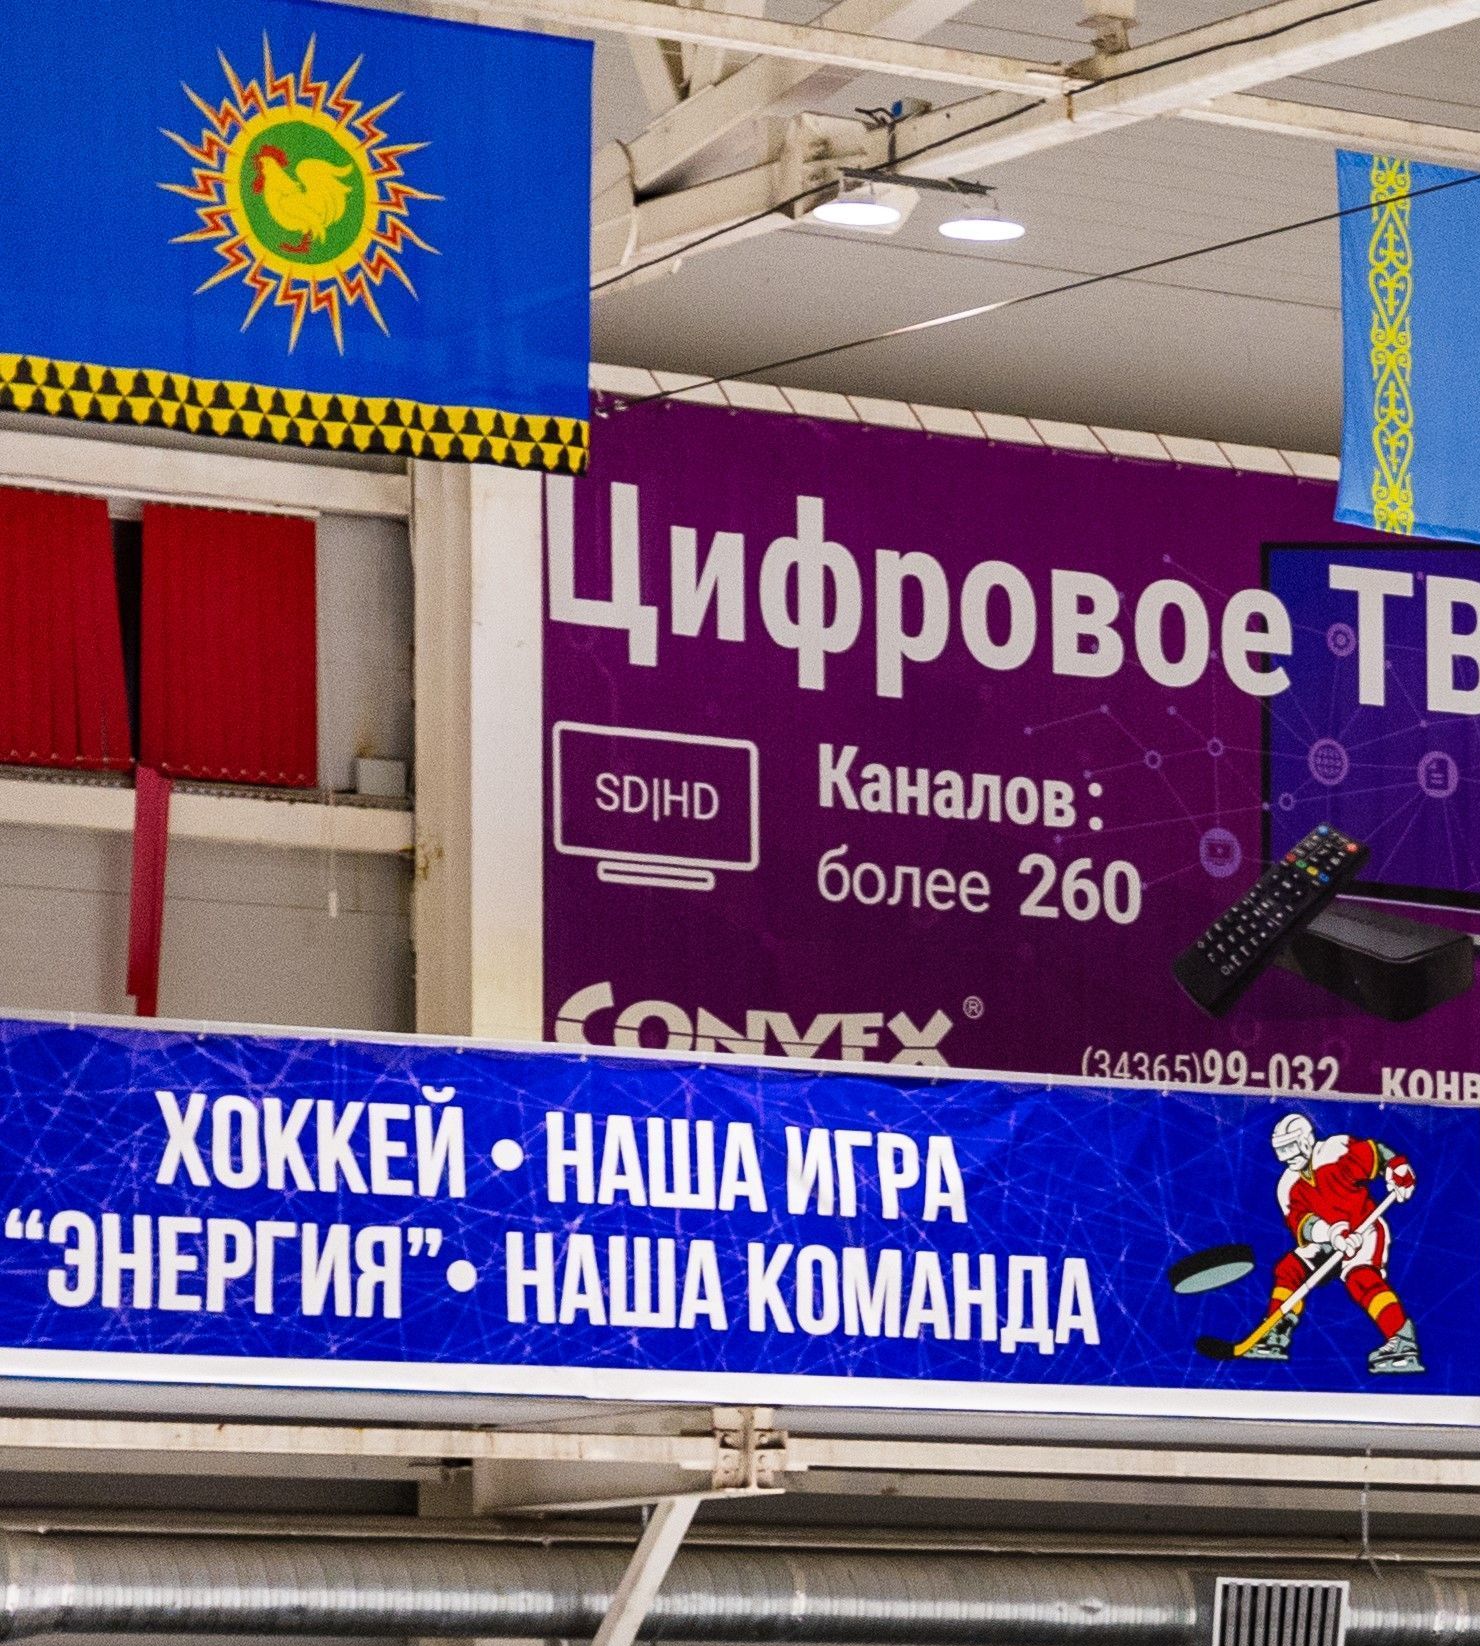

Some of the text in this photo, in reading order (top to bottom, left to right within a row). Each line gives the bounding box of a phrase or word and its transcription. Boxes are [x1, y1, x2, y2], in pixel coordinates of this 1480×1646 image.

[545, 474, 1293, 699] Цифровое
[817, 742, 1104, 831] Каналов:
[817, 843, 1143, 925] более 260
[155, 1085, 968, 1224] ХОККЕЙ НАША ИГРА
[506, 1230, 728, 1331] НАША
[748, 1241, 1101, 1355] КОМАНДА
